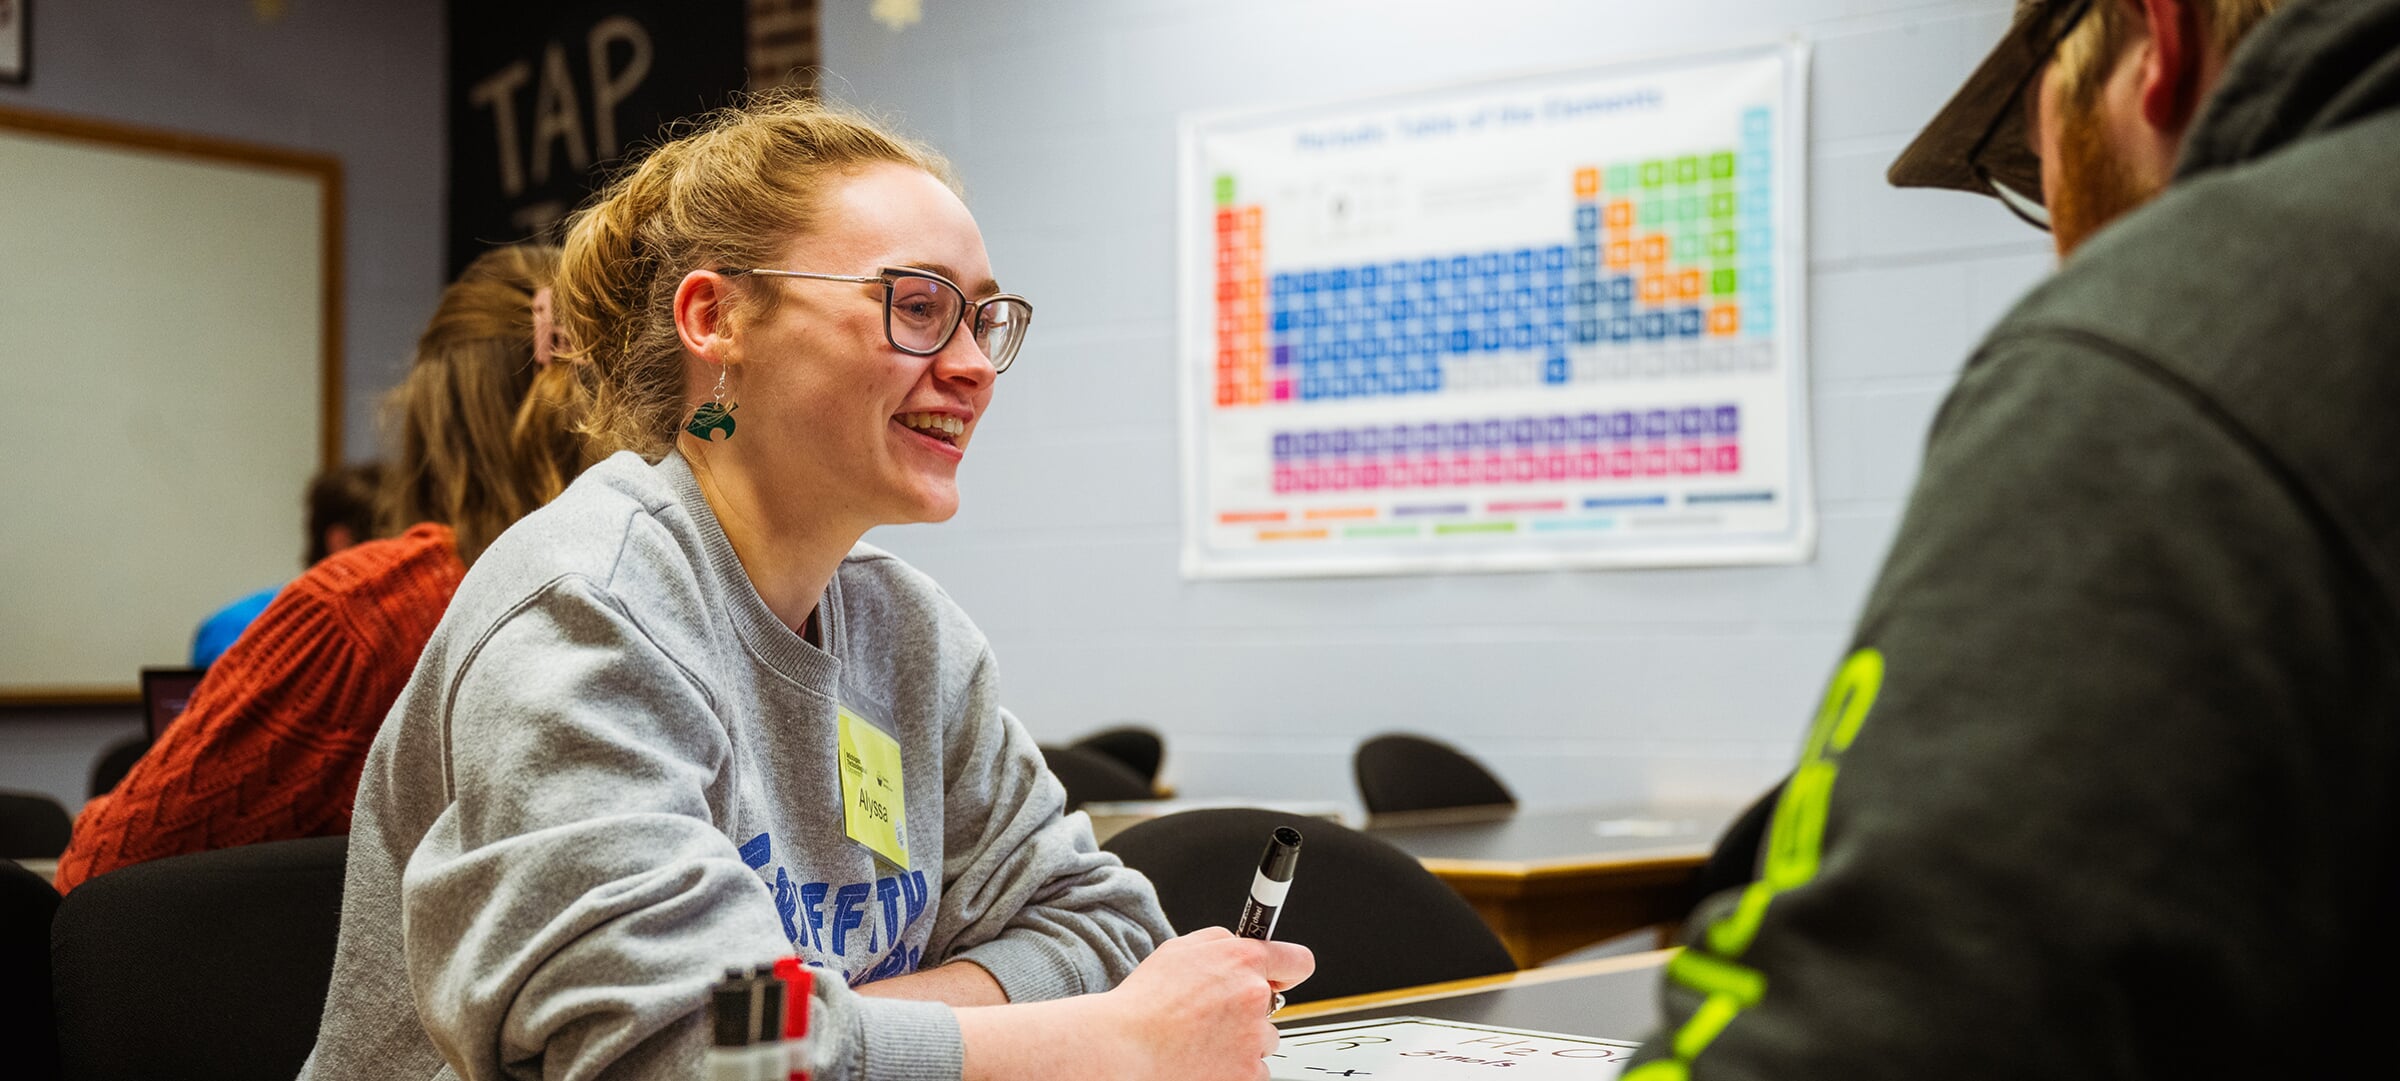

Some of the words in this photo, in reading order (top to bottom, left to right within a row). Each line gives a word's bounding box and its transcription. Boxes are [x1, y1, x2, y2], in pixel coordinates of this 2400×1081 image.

[469, 15, 653, 195] TAP
[1398, 115, 1457, 139] Table
[859, 788, 888, 823] Alyssa
[1252, 905, 1264, 924] chisel
